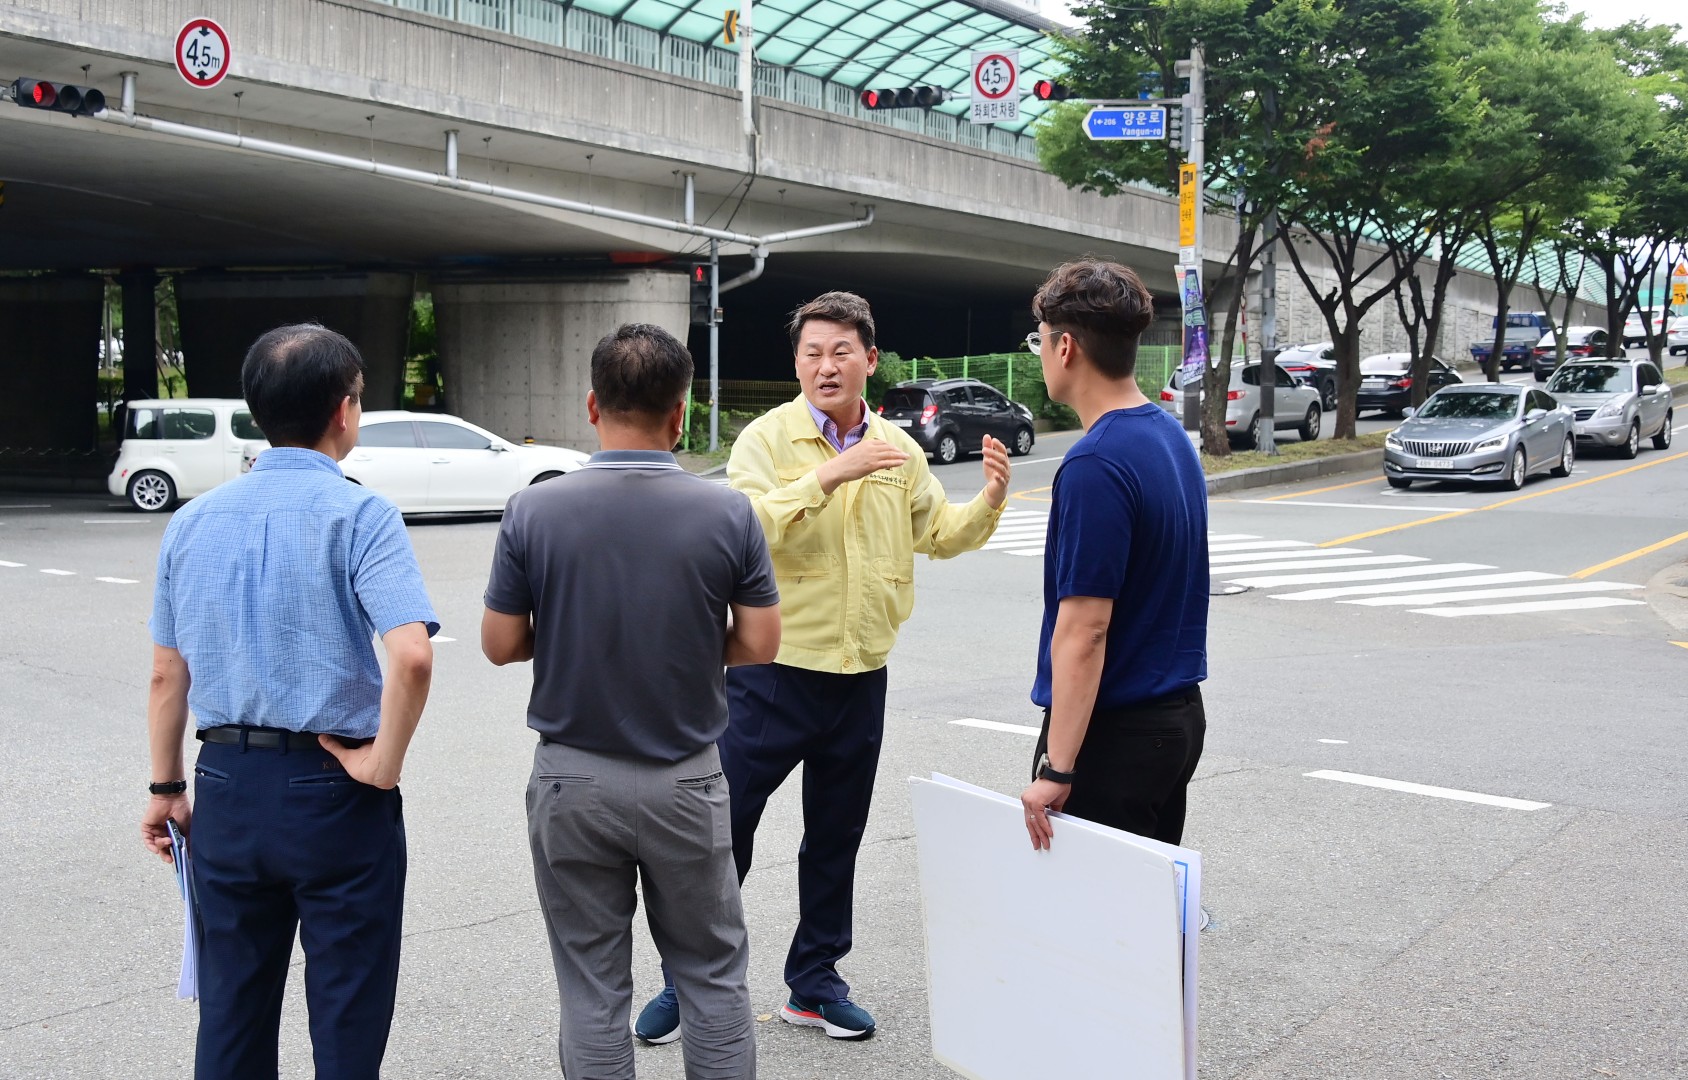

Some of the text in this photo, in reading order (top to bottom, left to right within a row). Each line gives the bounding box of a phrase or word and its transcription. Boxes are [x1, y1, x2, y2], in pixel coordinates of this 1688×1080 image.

[186, 38, 220, 69] 4.5m
[981, 67, 1009, 86] 4.5m
[974, 102, 1016, 119] 좌회전차량
[1122, 111, 1160, 126] 양운로
[1121, 127, 1162, 137] Yangun-ro
